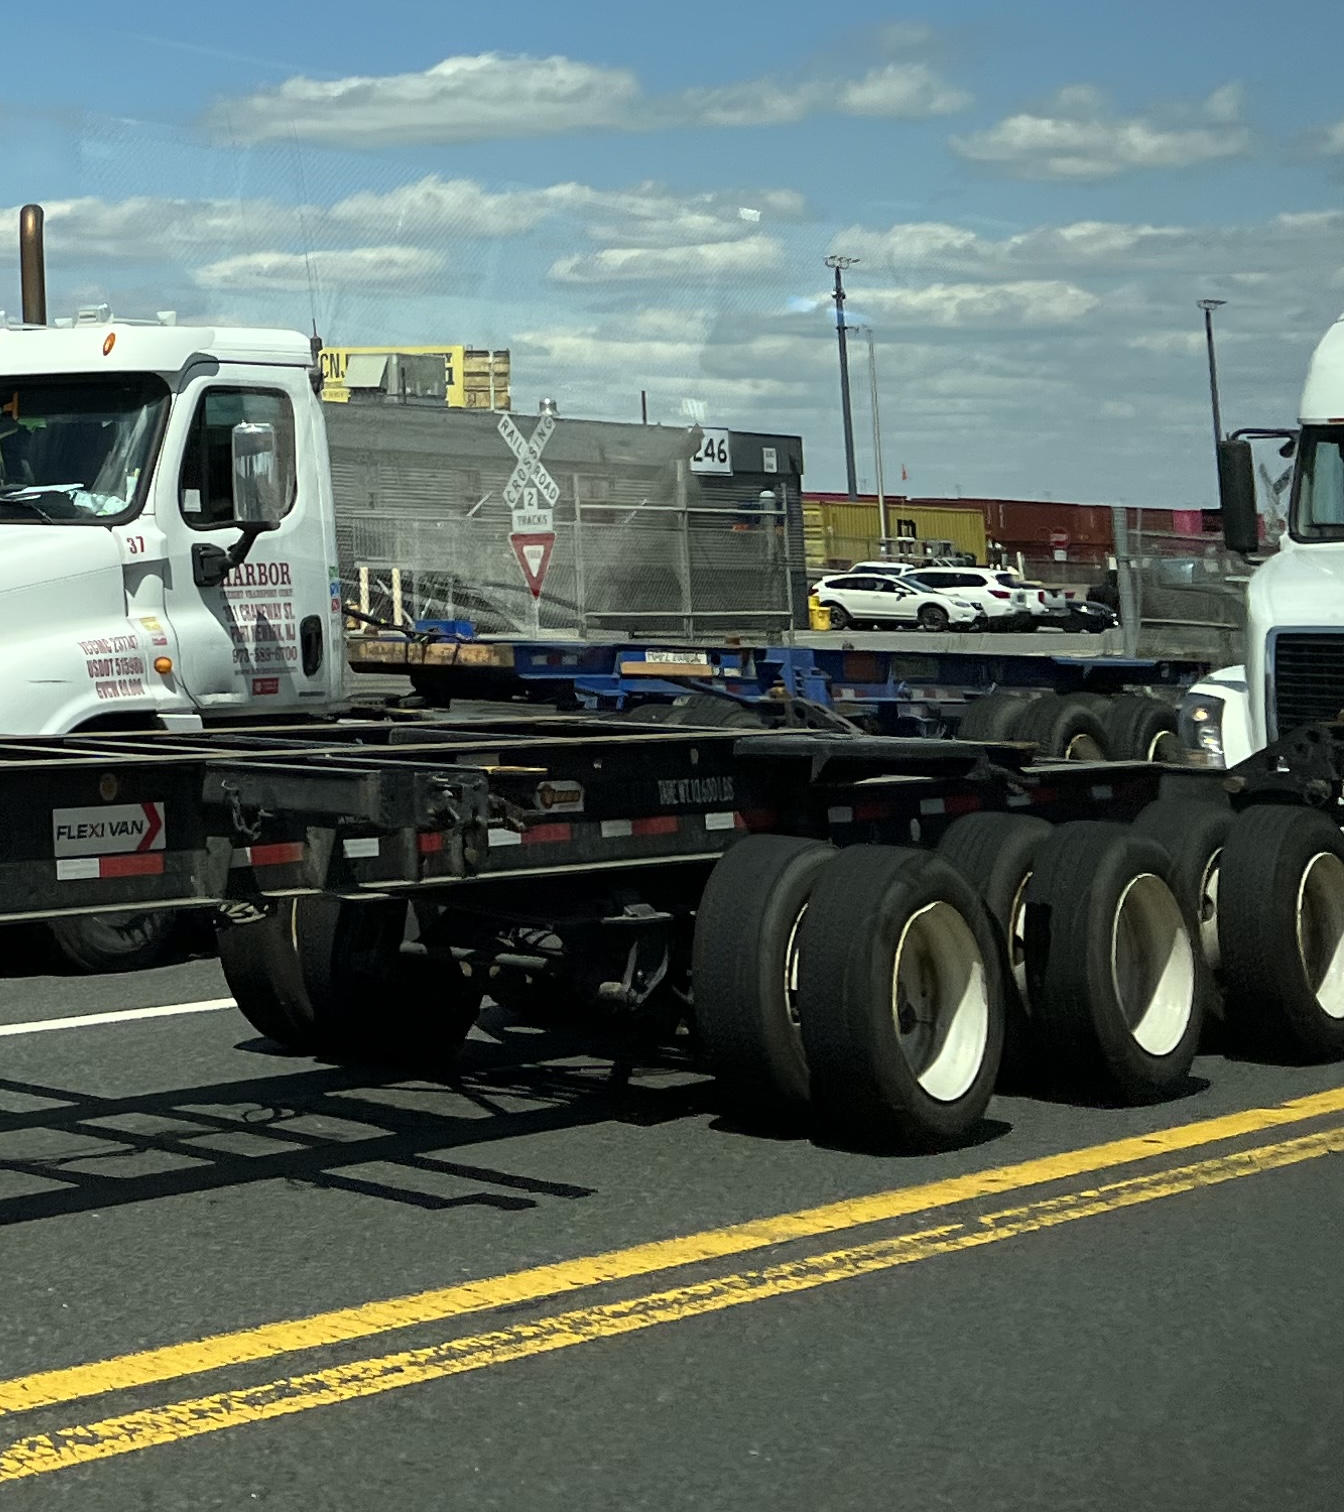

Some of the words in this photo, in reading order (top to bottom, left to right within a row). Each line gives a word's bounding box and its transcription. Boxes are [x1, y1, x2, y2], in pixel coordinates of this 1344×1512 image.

[506, 417, 554, 504] CROSSING
[527, 492, 534, 507] 2
[516, 514, 548, 527] TRACKS
[127, 536, 145, 554] 37
[56, 823, 105, 841] FLEXI
[108, 820, 144, 837] VAN
